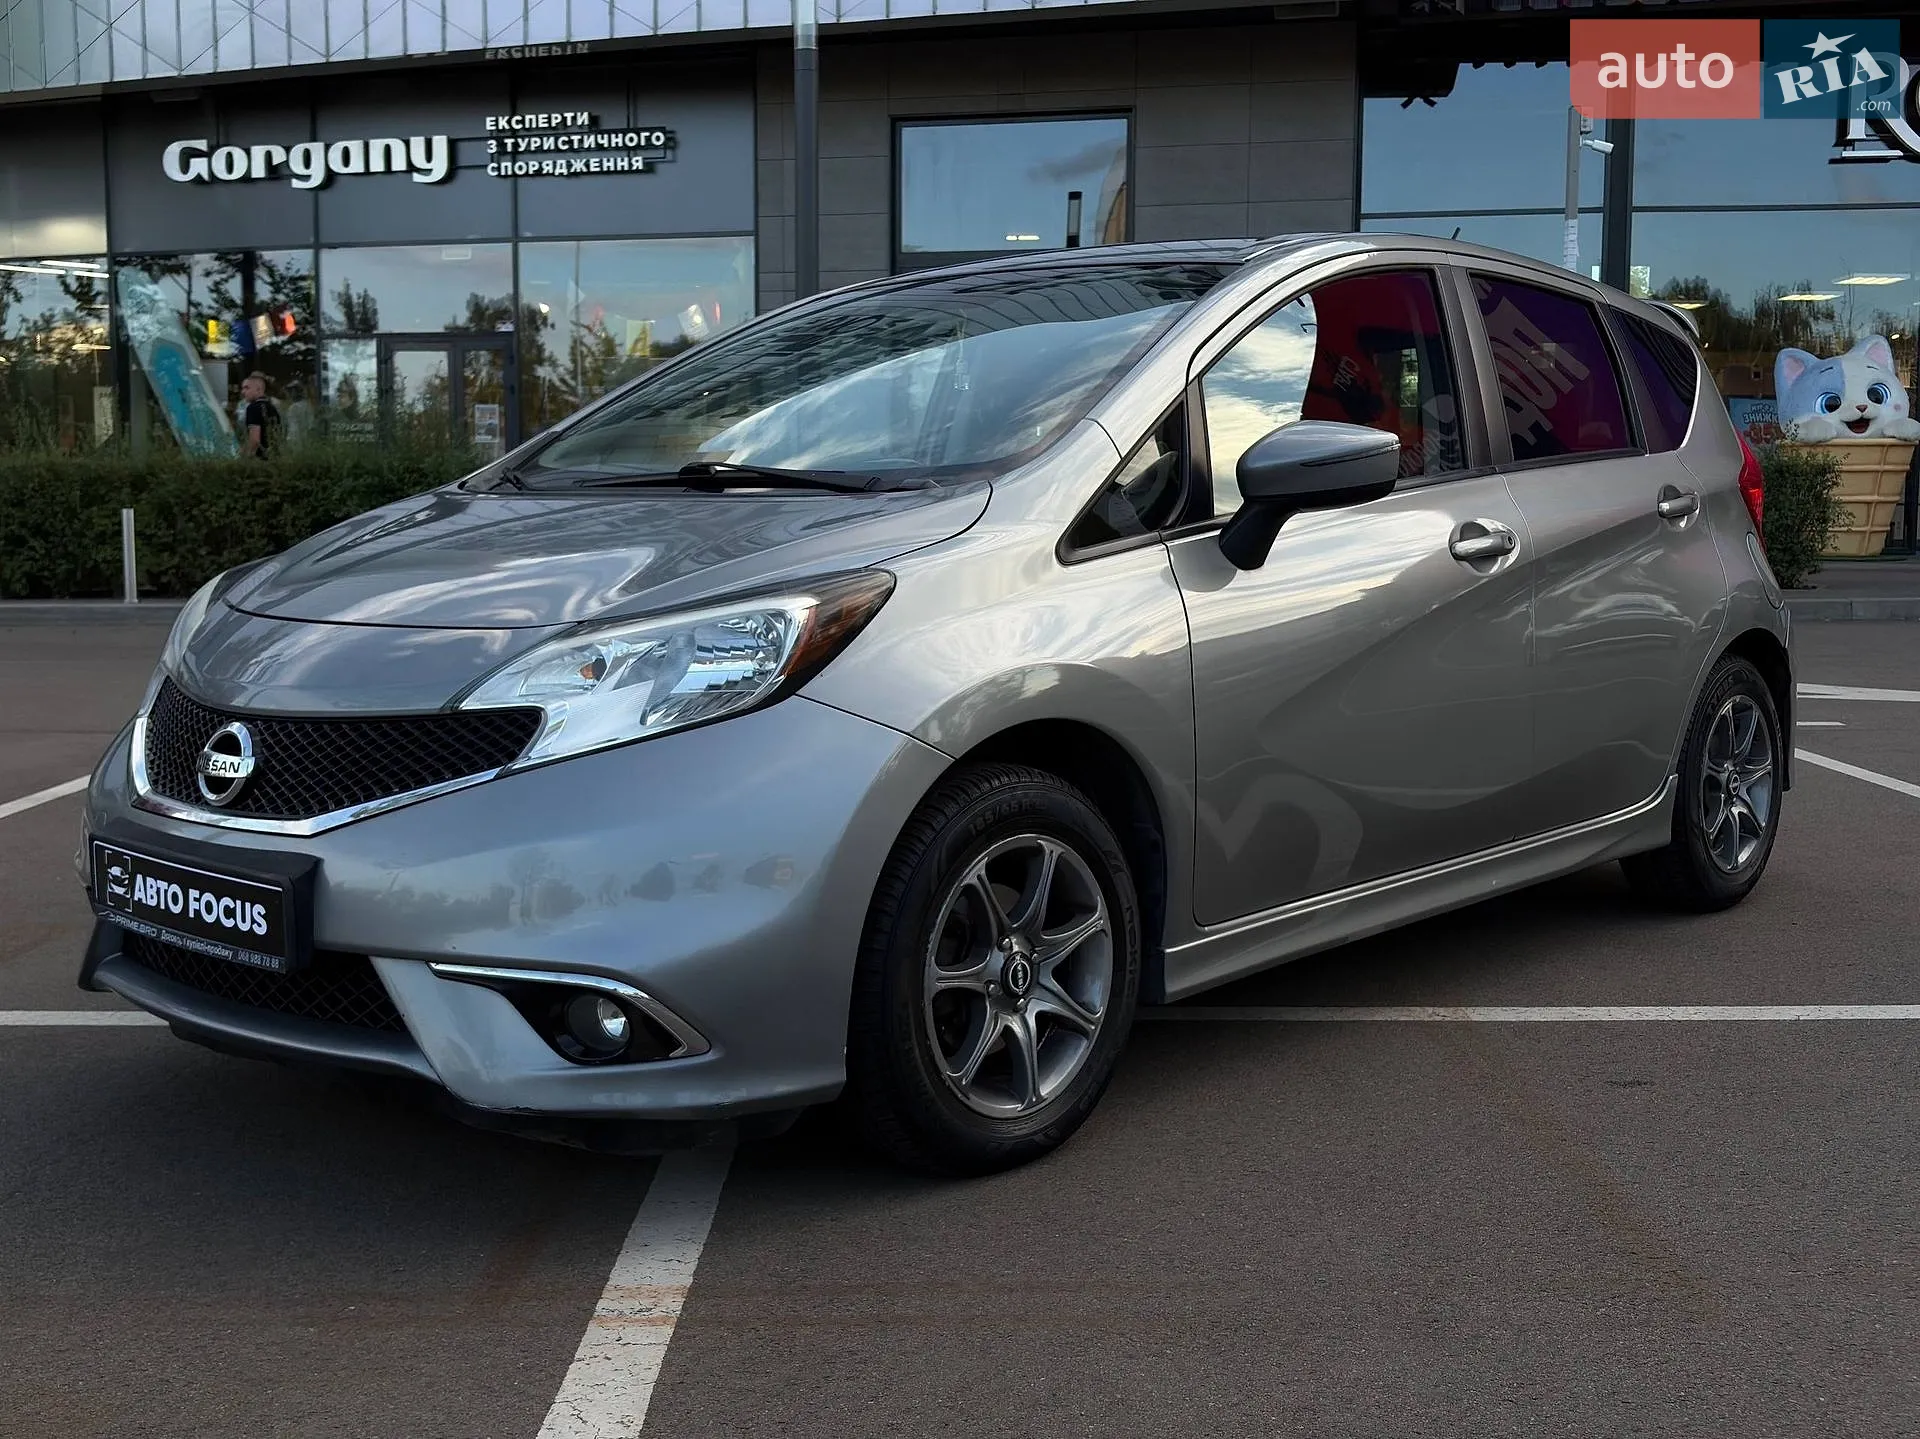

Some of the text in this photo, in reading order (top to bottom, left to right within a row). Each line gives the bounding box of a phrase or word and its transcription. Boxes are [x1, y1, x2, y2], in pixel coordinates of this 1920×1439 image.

[485, 112, 590, 130] ЕКСПЕРТИ
[504, 132, 665, 153] ТУРИСТИЧНОГО
[162, 135, 448, 189] Gorgany
[487, 156, 643, 176] СПОРЯДЖЕННЯ
[133, 873, 268, 935] АВТО FOCUS
